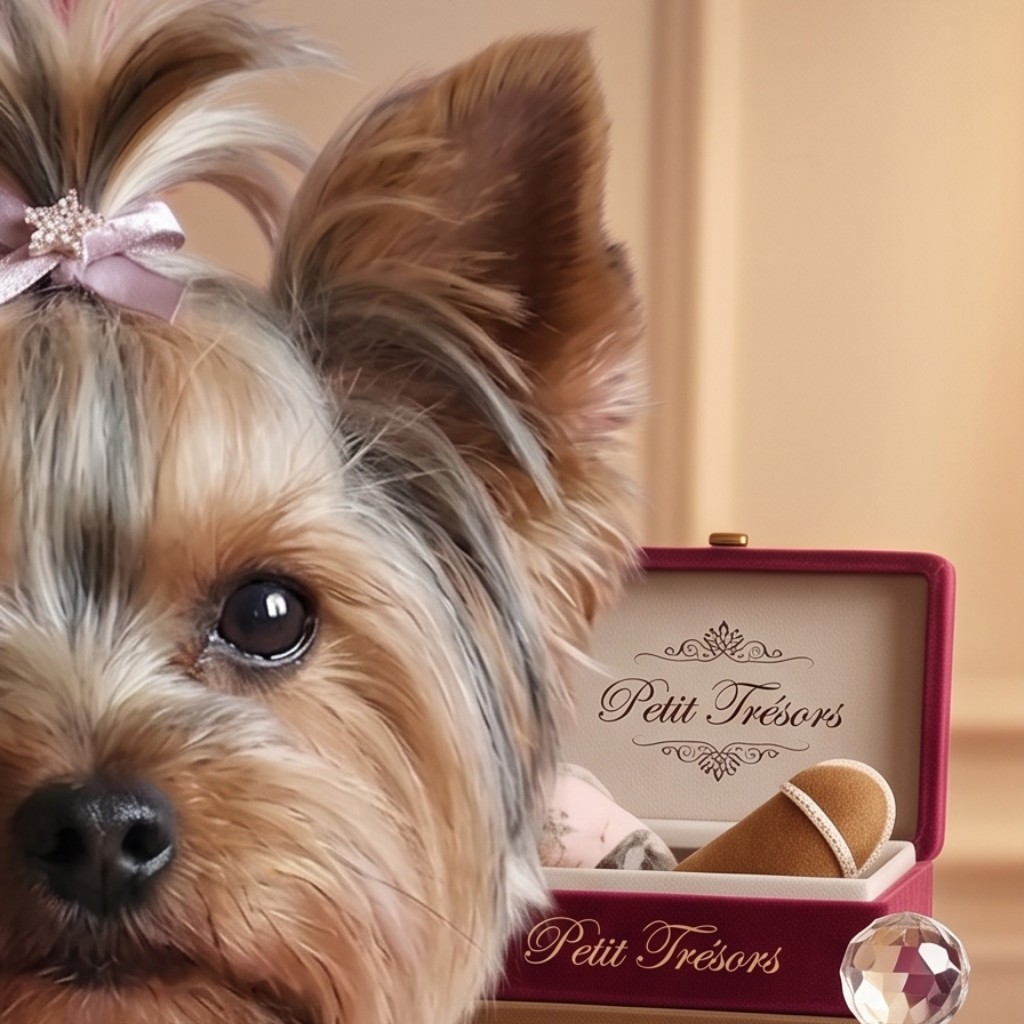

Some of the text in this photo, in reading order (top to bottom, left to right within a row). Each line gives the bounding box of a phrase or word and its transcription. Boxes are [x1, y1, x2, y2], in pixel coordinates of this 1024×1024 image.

[598, 677, 845, 728] Petit Trésors
[524, 916, 782, 974] Petit Trésors
